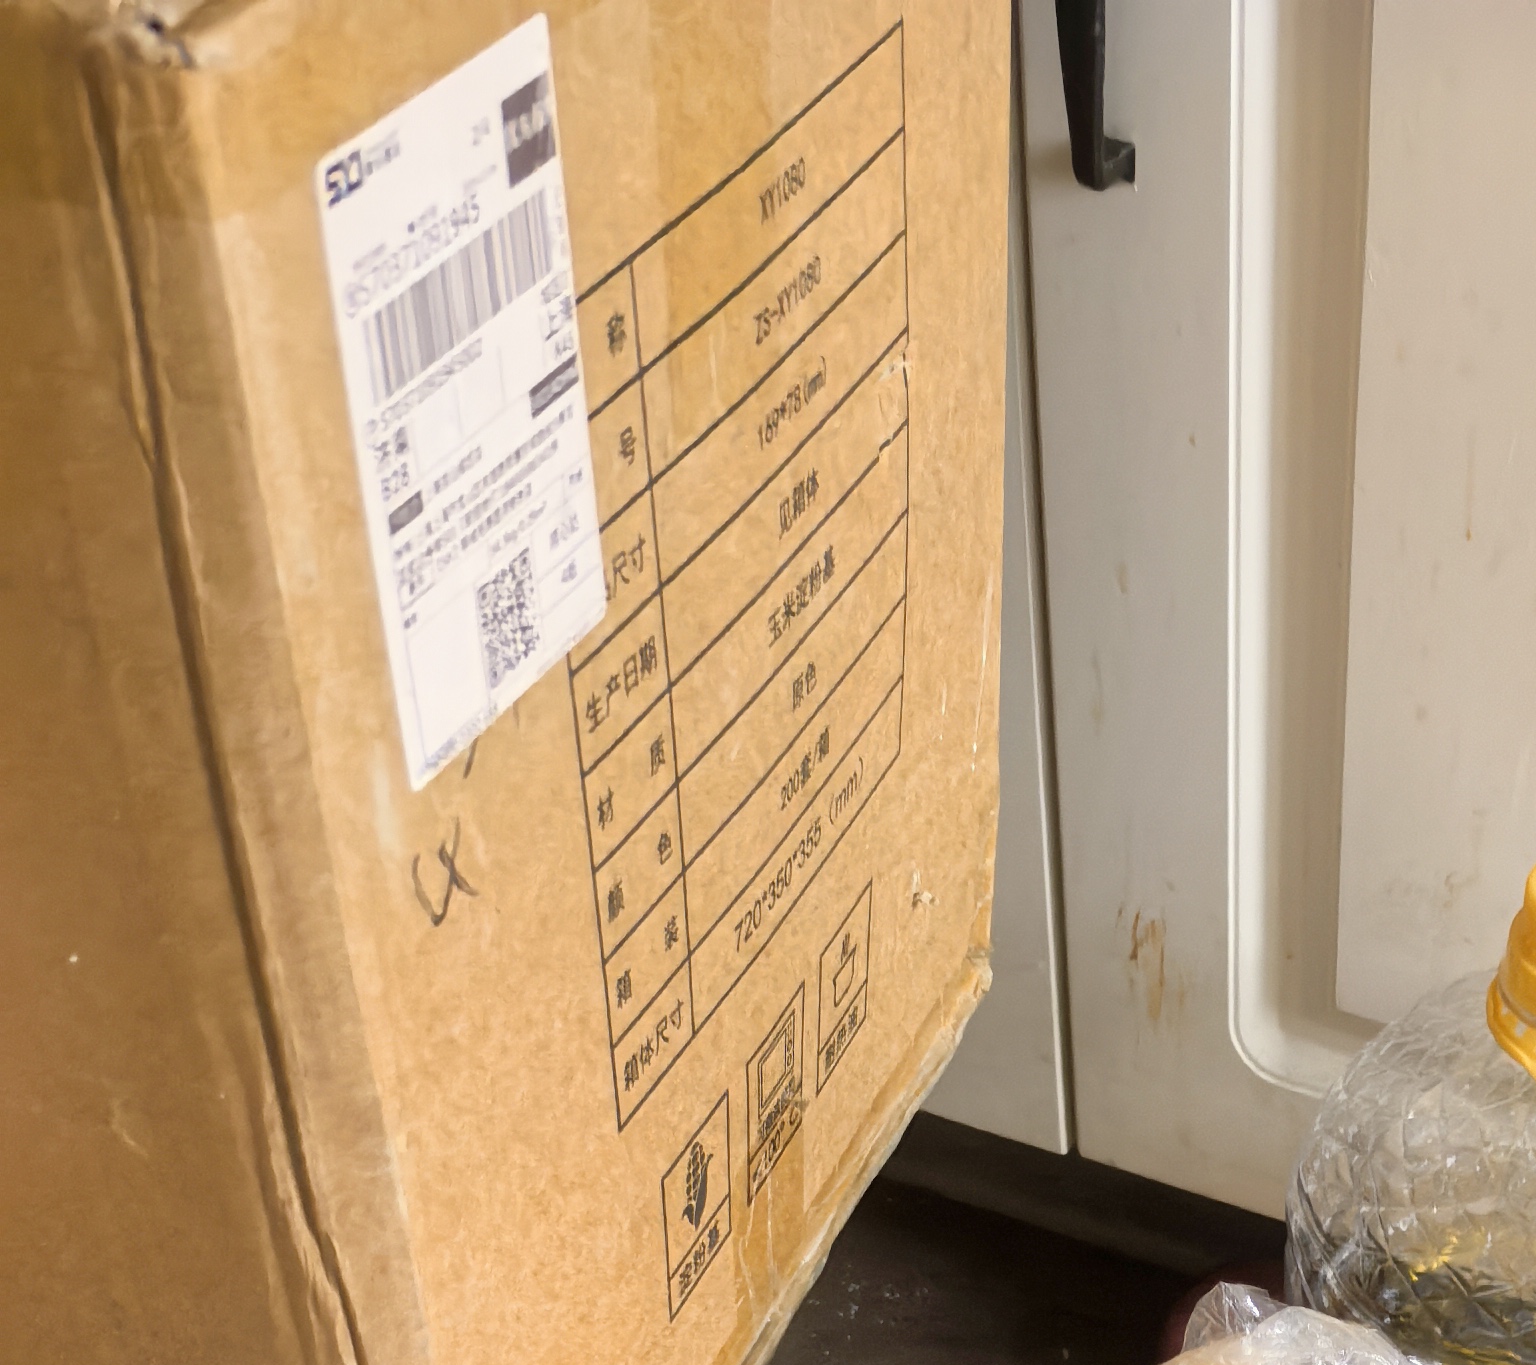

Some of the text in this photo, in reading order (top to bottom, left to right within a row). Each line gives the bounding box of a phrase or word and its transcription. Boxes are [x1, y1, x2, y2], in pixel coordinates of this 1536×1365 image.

[619, 426, 638, 467] 号
[604, 532, 647, 601] 尺寸
[584, 633, 659, 734] 生产日期
[792, 660, 818, 713] 原色
[657, 831, 674, 866] 色
[623, 997, 685, 1093] 箱体尺寸
